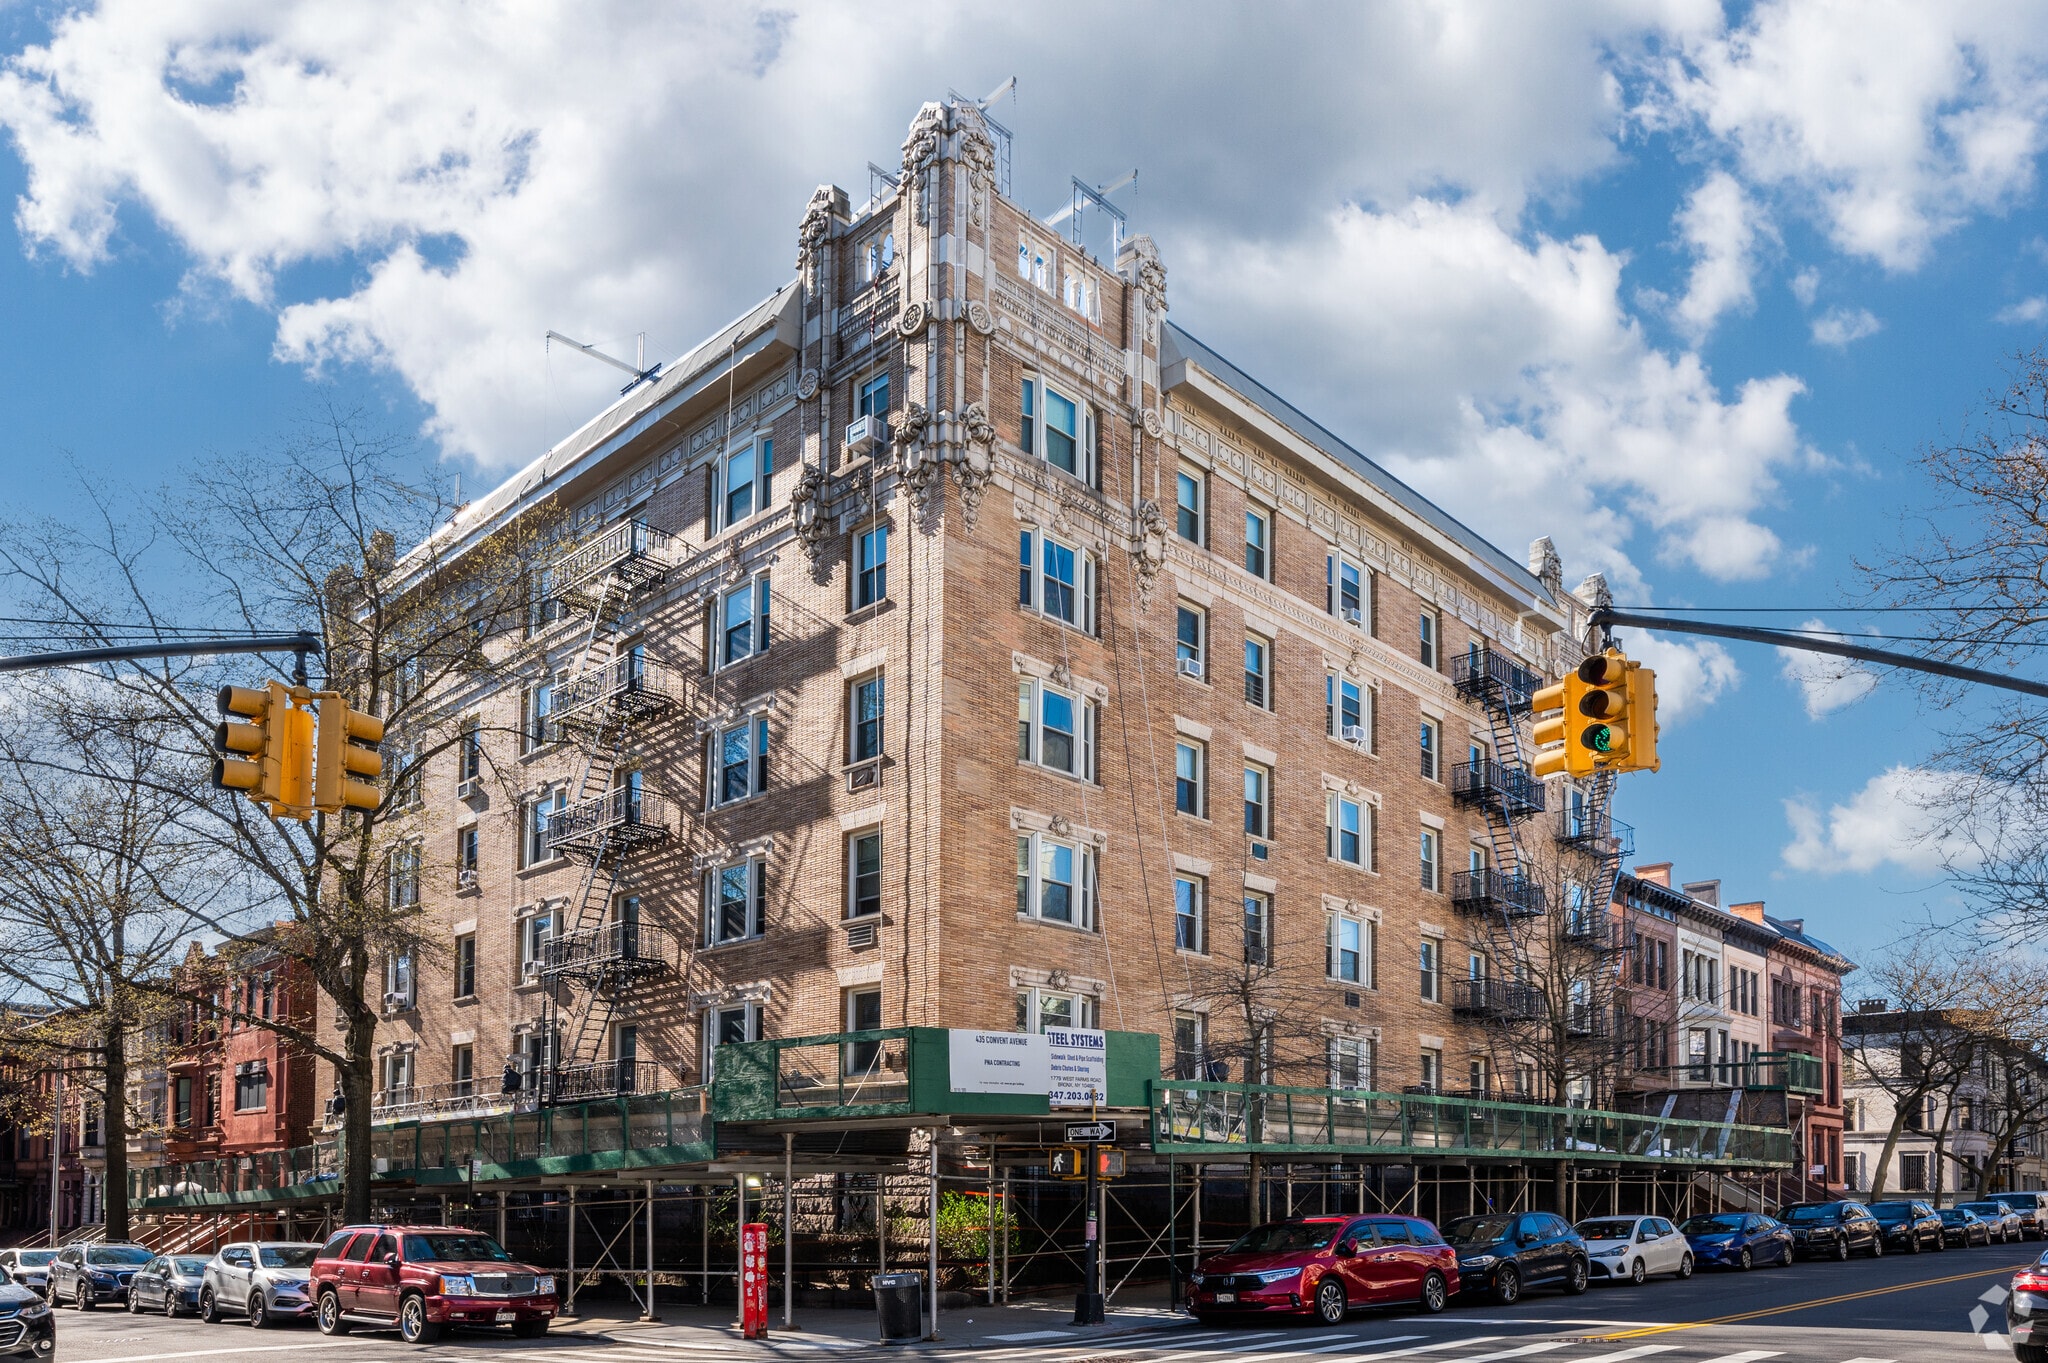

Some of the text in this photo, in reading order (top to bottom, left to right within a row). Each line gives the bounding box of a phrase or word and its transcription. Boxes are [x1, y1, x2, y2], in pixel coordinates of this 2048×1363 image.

[975, 1035, 1028, 1046] 435 CONVENT AVENUE
[1071, 1034, 1103, 1048] SYSTEMS
[993, 1059, 1021, 1067] CONTRACTING
[1070, 1127, 1105, 1136] ONE WAY
